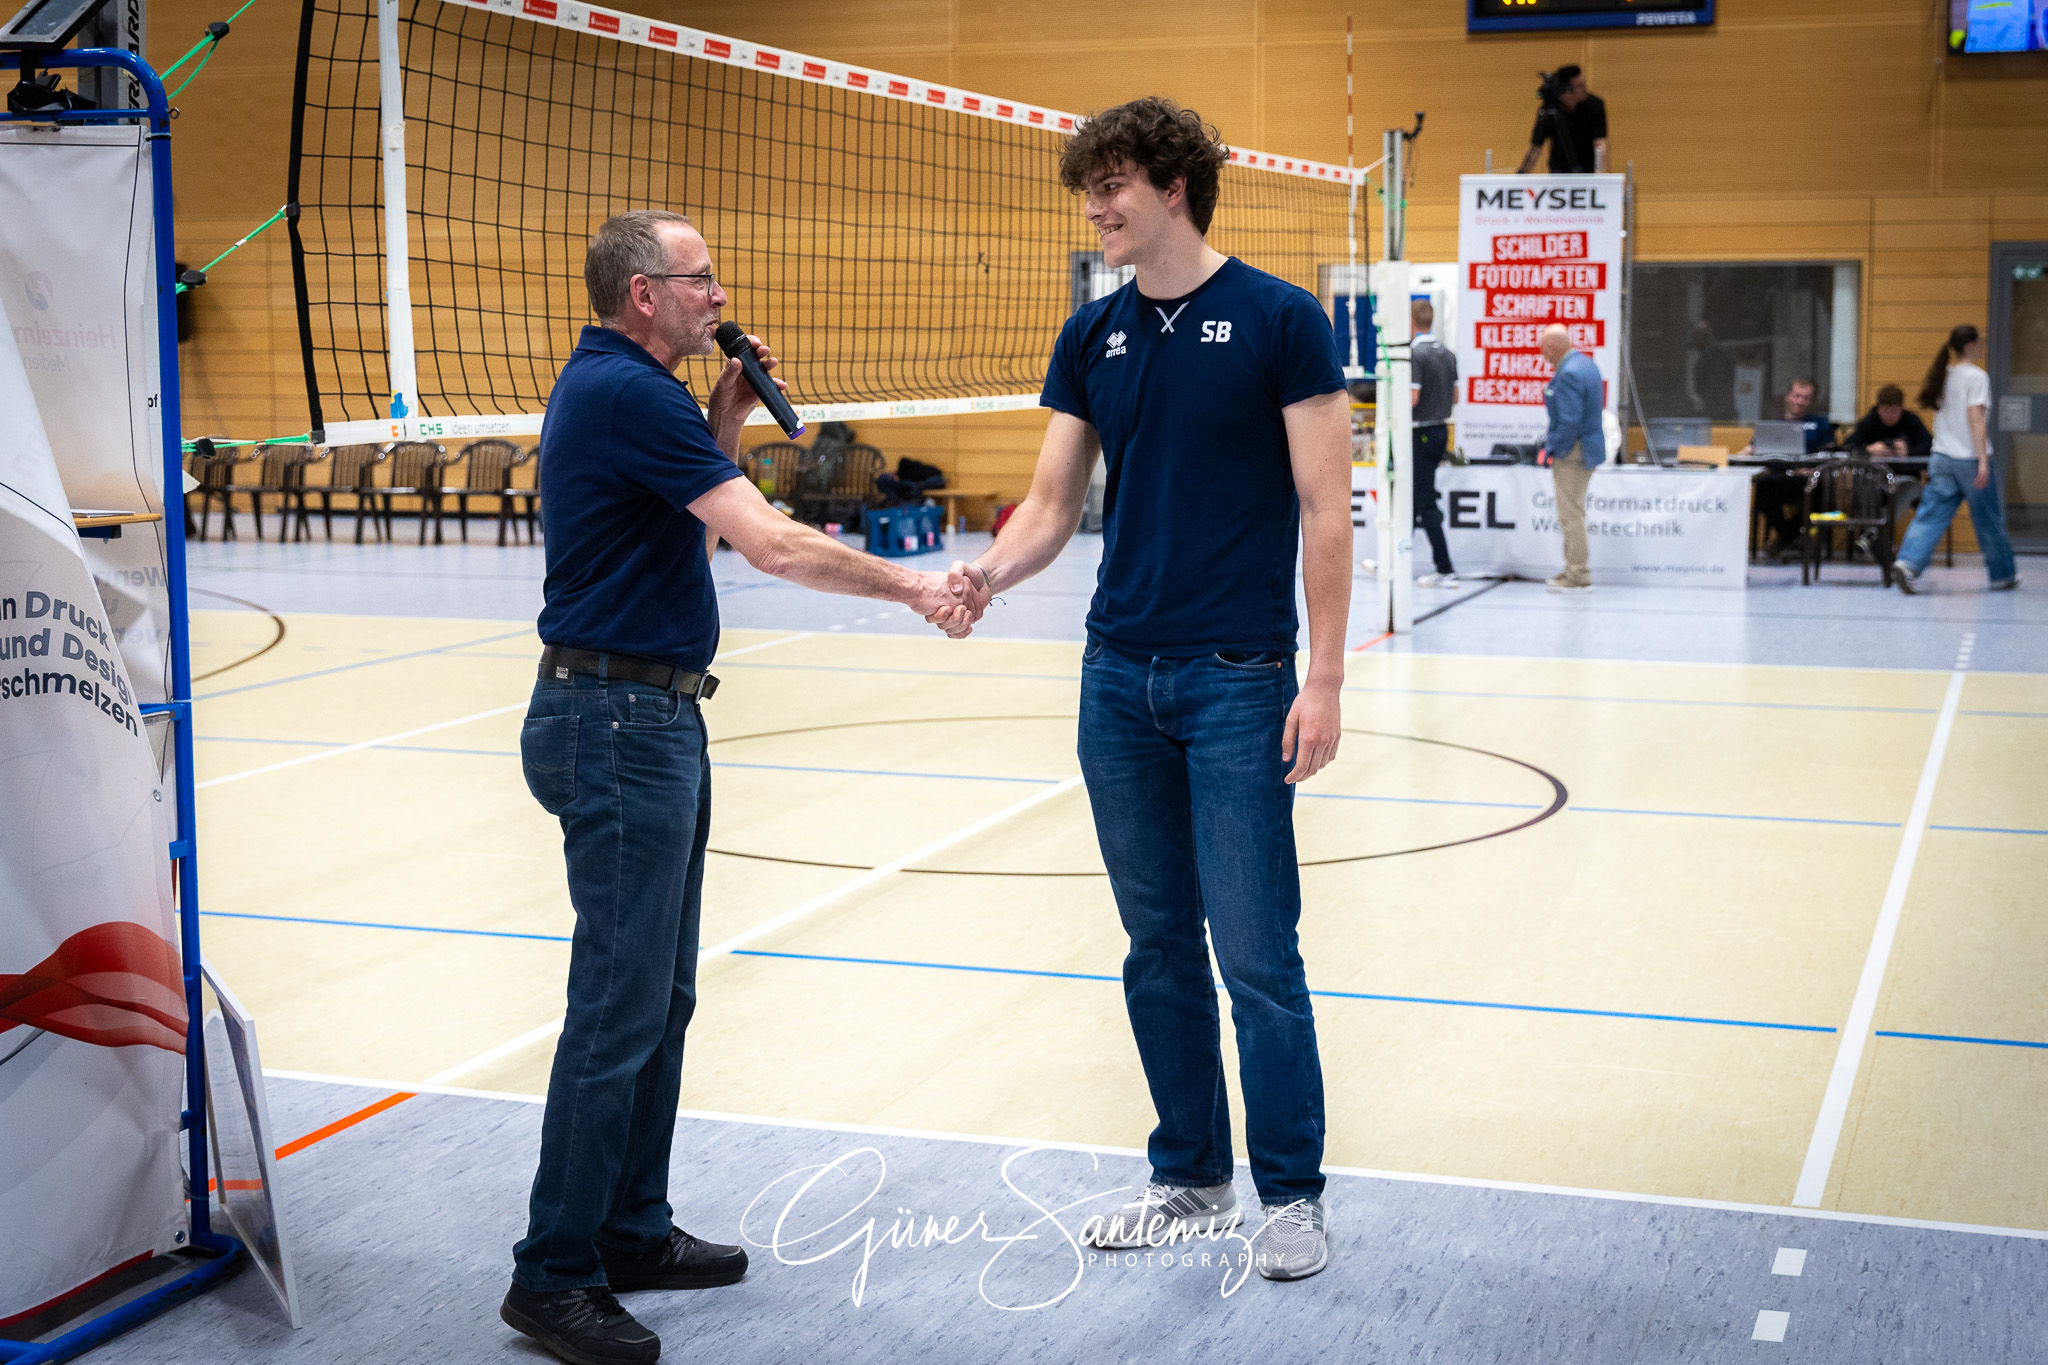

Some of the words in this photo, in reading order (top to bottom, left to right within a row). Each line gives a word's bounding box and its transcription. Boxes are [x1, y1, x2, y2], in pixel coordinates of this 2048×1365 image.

[1476, 188, 1606, 209] MEYSEL
[1496, 233, 1584, 260] SCHILDER
[1475, 264, 1599, 289] FOTOTAPETEN
[1491, 293, 1588, 319] SCHRIFTEN
[1200, 320, 1232, 343] SB
[25, 591, 109, 652] Druck
[62, 632, 134, 706] Desig
[0, 667, 139, 737] schmelzen
